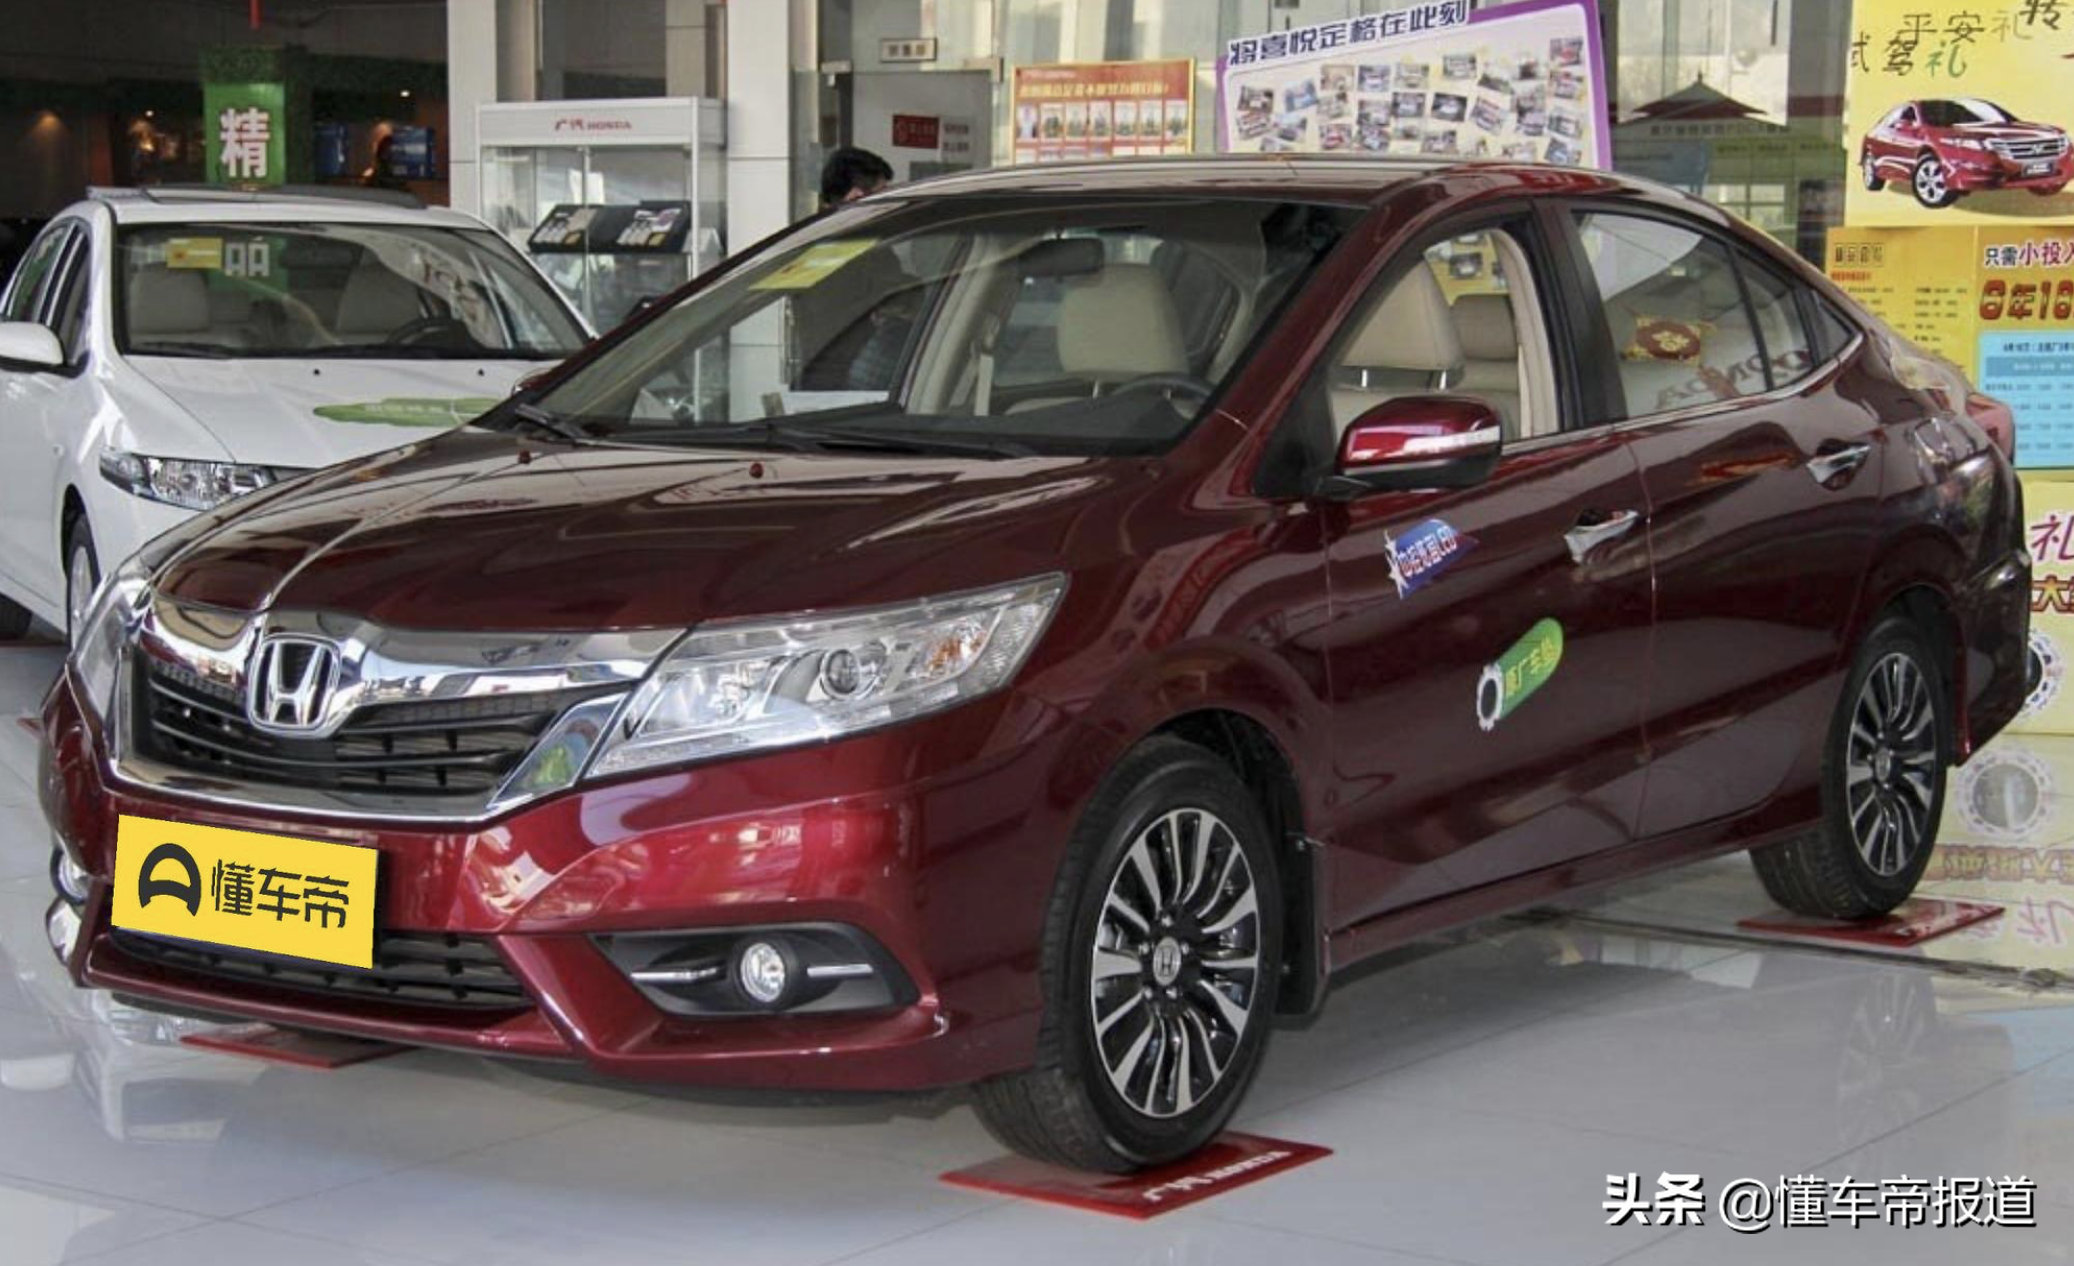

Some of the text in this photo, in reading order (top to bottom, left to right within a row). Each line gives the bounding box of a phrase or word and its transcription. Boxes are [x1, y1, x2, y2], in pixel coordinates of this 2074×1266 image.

[1230, 1, 1467, 66] 将喜悦定格在此刻
[1897, 11, 2034, 44] 平安礼
